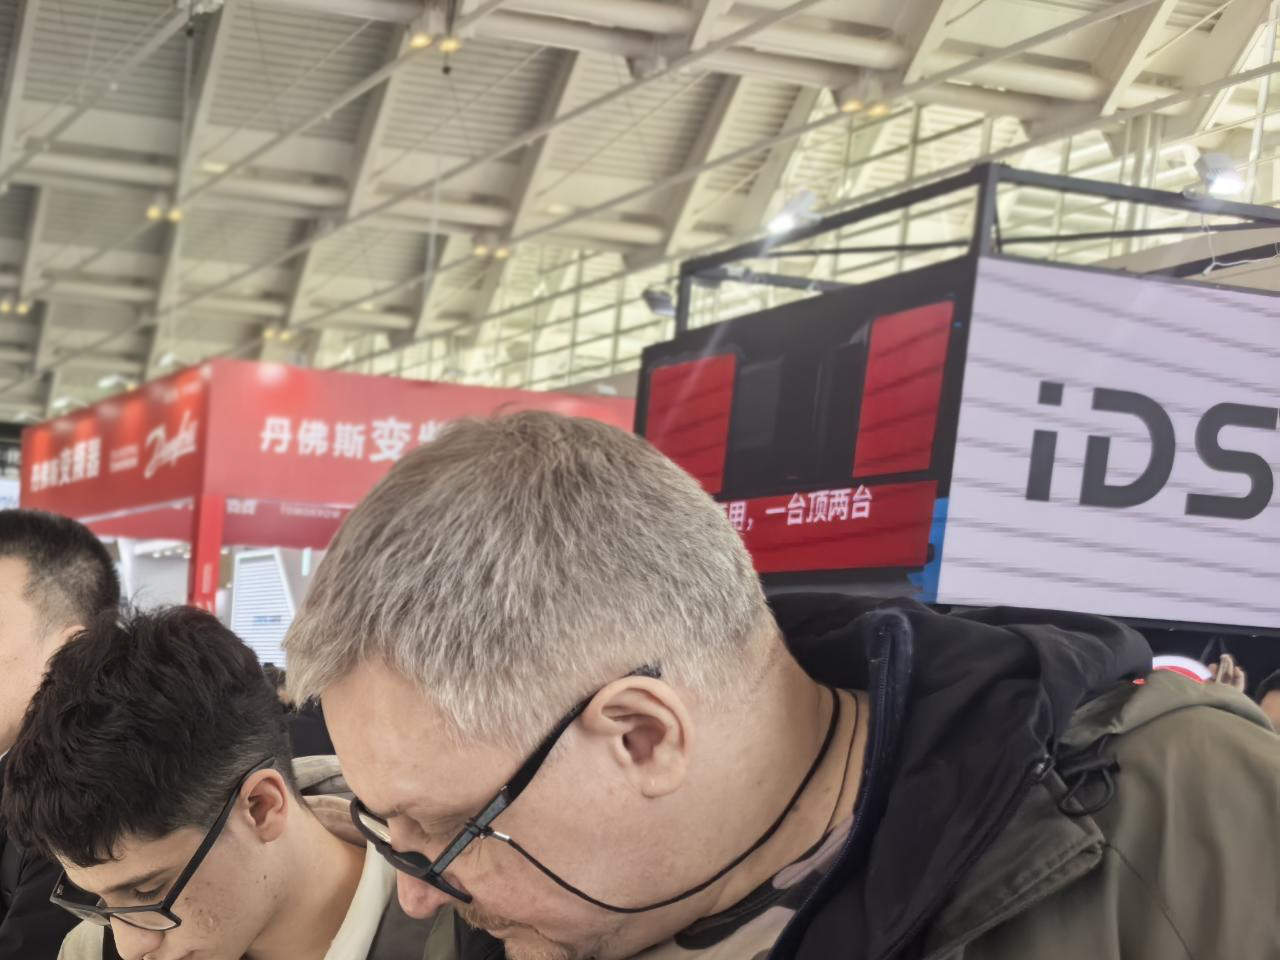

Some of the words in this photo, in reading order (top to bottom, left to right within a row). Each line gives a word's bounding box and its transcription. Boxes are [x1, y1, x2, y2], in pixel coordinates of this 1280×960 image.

[1025, 381, 1278, 520] iDS
[722, 484, 873, 532] 用，一台顶两台
